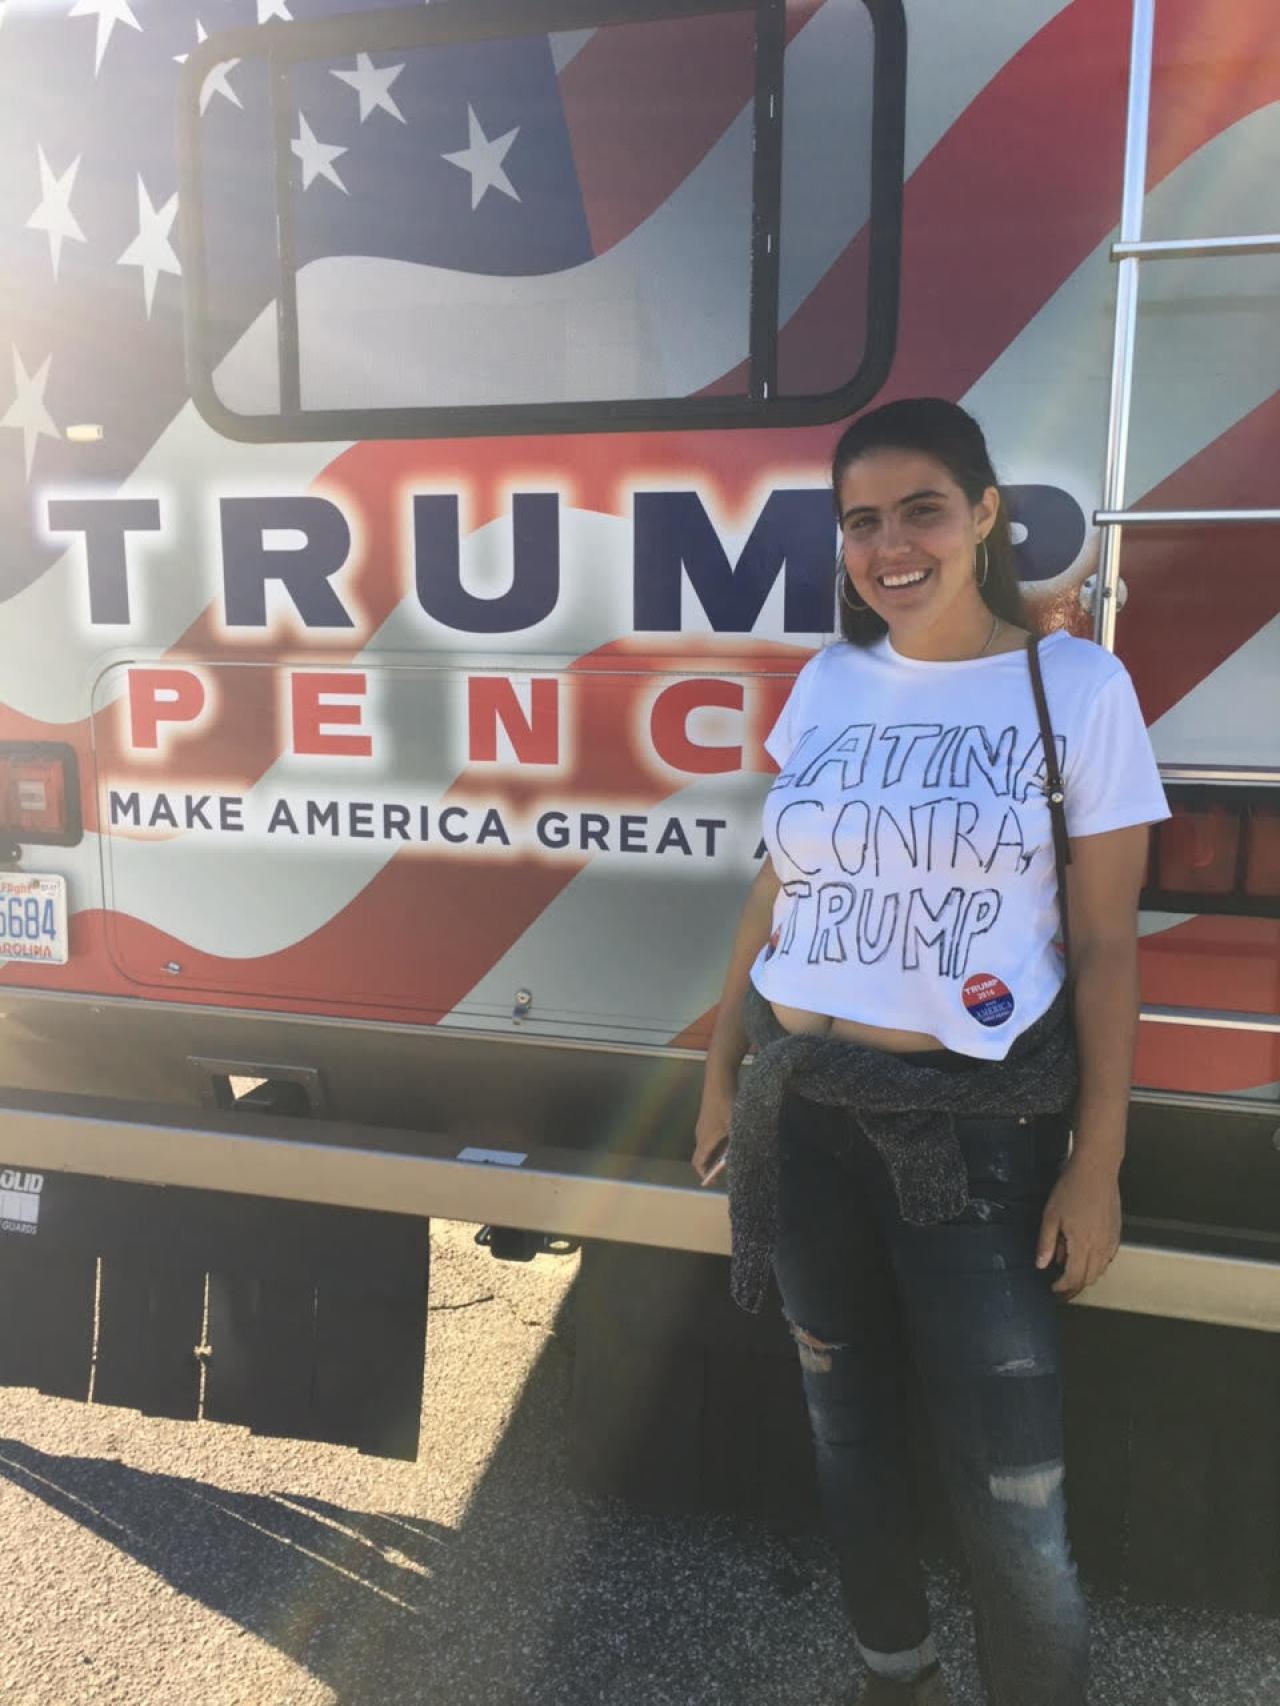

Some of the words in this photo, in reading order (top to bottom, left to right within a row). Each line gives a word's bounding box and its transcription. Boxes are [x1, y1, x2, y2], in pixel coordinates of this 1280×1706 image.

[128, 669, 744, 775] PENC
[768, 723, 1067, 804] LATINA
[109, 790, 245, 832] MAKE
[267, 798, 512, 846] AMERICA
[536, 811, 727, 857] GREAT
[779, 879, 1003, 980] TRUMP
[963, 979, 998, 996] TRUMP
